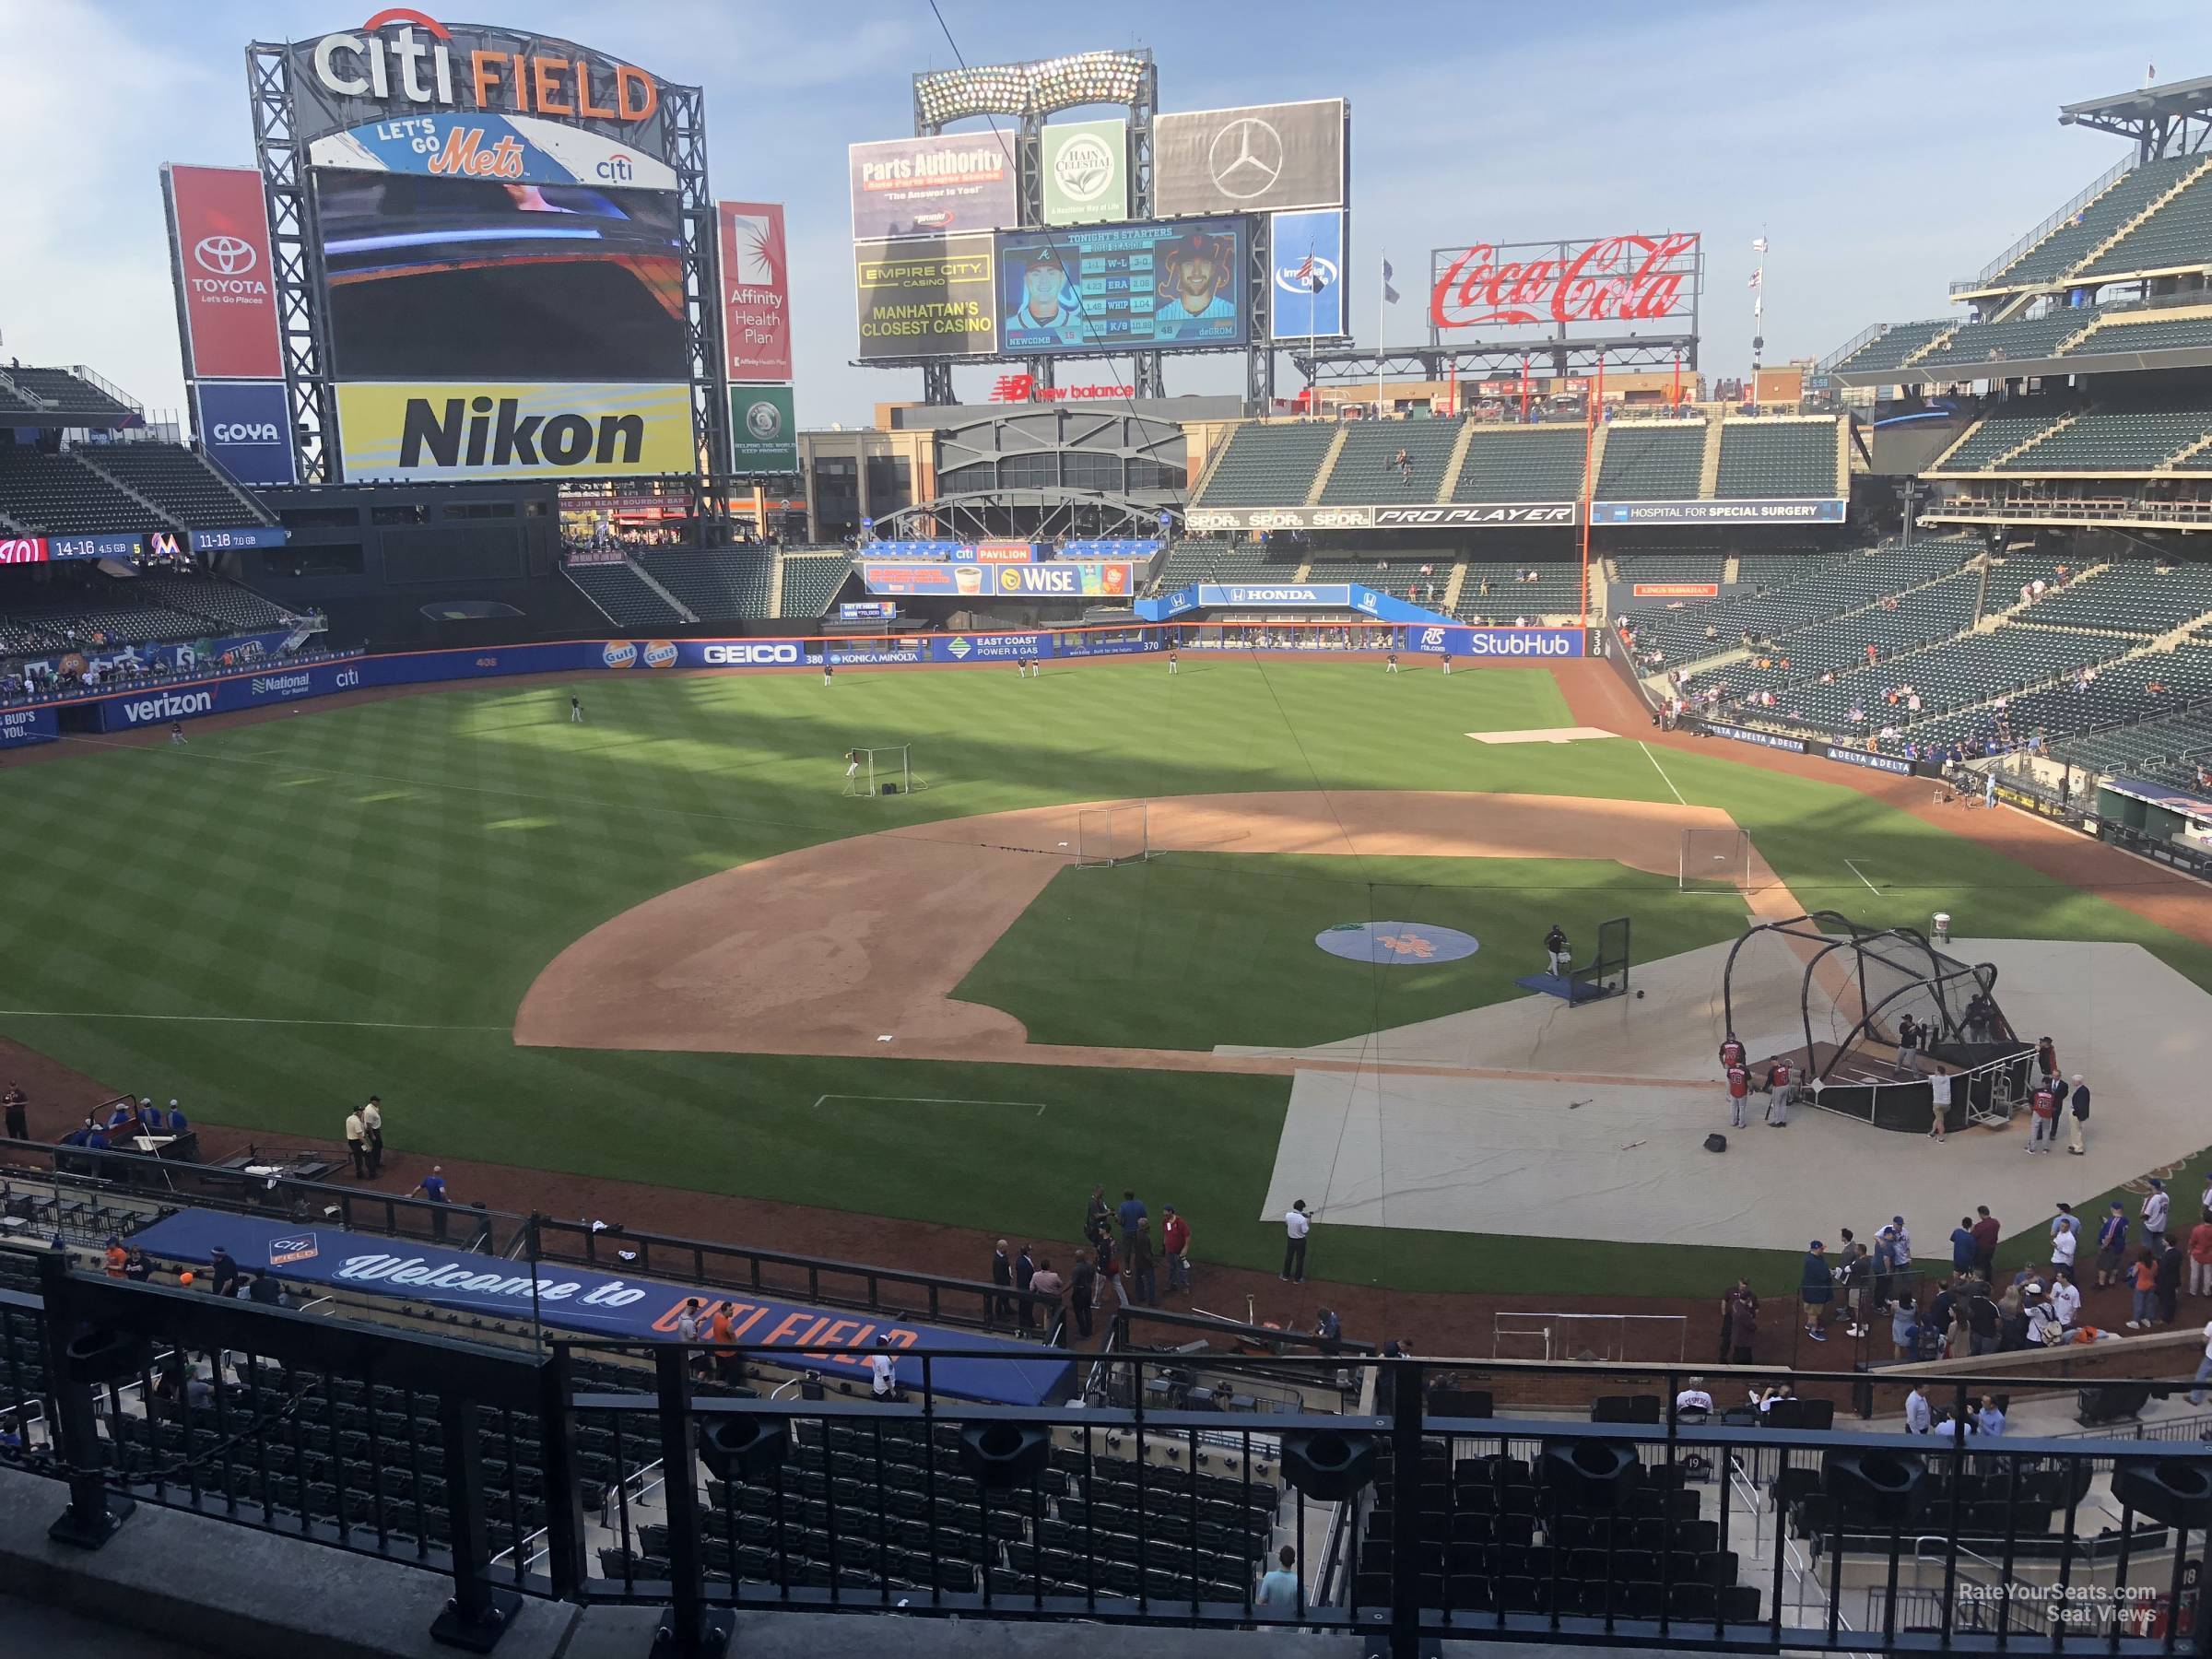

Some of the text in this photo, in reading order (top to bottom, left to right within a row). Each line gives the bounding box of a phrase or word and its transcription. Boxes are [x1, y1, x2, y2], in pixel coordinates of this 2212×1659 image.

[314, 26, 658, 123] citi FIELD
[376, 118, 437, 141] LET'S
[411, 135, 440, 154] GO
[428, 126, 525, 178] Mets
[1069, 150, 1099, 161] HAIN
[596, 158, 633, 181] citi
[863, 149, 1004, 182] Parts Authority
[908, 189, 944, 199] Answer
[946, 187, 956, 196] Is
[1068, 228, 1173, 243] TONIGHT'S STARTERS
[1108, 259, 1127, 267] W-L
[866, 263, 982, 280] EMPIRE CITY
[192, 278, 267, 294] TOYOTA
[903, 278, 946, 288] CASINO
[1108, 280, 1128, 289] ERA
[201, 295, 221, 303] Let's
[236, 296, 263, 304] Places
[731, 288, 782, 309] Affinity
[1108, 300, 1128, 310] WHIP
[735, 310, 781, 326] Health
[873, 301, 979, 320] MANHATTAN'S
[862, 317, 992, 336] CLOSEST CASINO
[1199, 326, 1233, 335] deGROM
[745, 328, 773, 344] Plan
[1009, 336, 1051, 346] NEWCOMB
[1036, 387, 1067, 400] new
[1071, 383, 1134, 398] balance
[214, 424, 278, 441] GOYA
[399, 396, 644, 467] Nikon
[1376, 508, 1571, 523] PRO PLAYER
[1630, 507, 1683, 518] HOSPITAL
[1685, 508, 1707, 517] FOR
[1709, 506, 1759, 517] SPECIAL
[1761, 505, 1818, 517] SURGERY
[199, 533, 256, 548] 11-18 7.0 GB
[55, 542, 126, 556] 14-16 4.5 GB
[956, 547, 1028, 559] citi PAVILION
[1023, 567, 1074, 592] WISE
[1247, 589, 1317, 601] HONDA
[1169, 602, 1193, 616] HONDA
[1357, 602, 1379, 616] HONDA
[977, 636, 1038, 646] EAST COAST
[1421, 627, 1446, 645] RTS
[1472, 633, 1570, 654] StubHub
[1593, 629, 1602, 656] 330
[977, 646, 1039, 656] POWER & GAS
[1143, 641, 1159, 651] 370
[1420, 644, 1446, 653] rts.com
[606, 650, 636, 663] Gulf
[645, 648, 675, 663] Gulf
[704, 644, 798, 664] GEICO
[806, 654, 824, 665] 380
[842, 653, 919, 664] KONICA MINOLTA
[265, 673, 310, 691] National
[335, 668, 359, 688] citi
[124, 691, 212, 723] verizon
[5, 711, 36, 726] BUD'S
[3, 726, 28, 739] YOU.
[1741, 732, 1767, 744] DELTA
[1778, 738, 1804, 751] DELTA
[1838, 750, 1911, 773] DELTA DELTA
[274, 1239, 309, 1251] citi
[274, 1250, 315, 1262] FIELD
[335, 1253, 582, 1300] Welcome
[581, 1280, 646, 1307] to
[1688, 1458, 1700, 1468] 19
